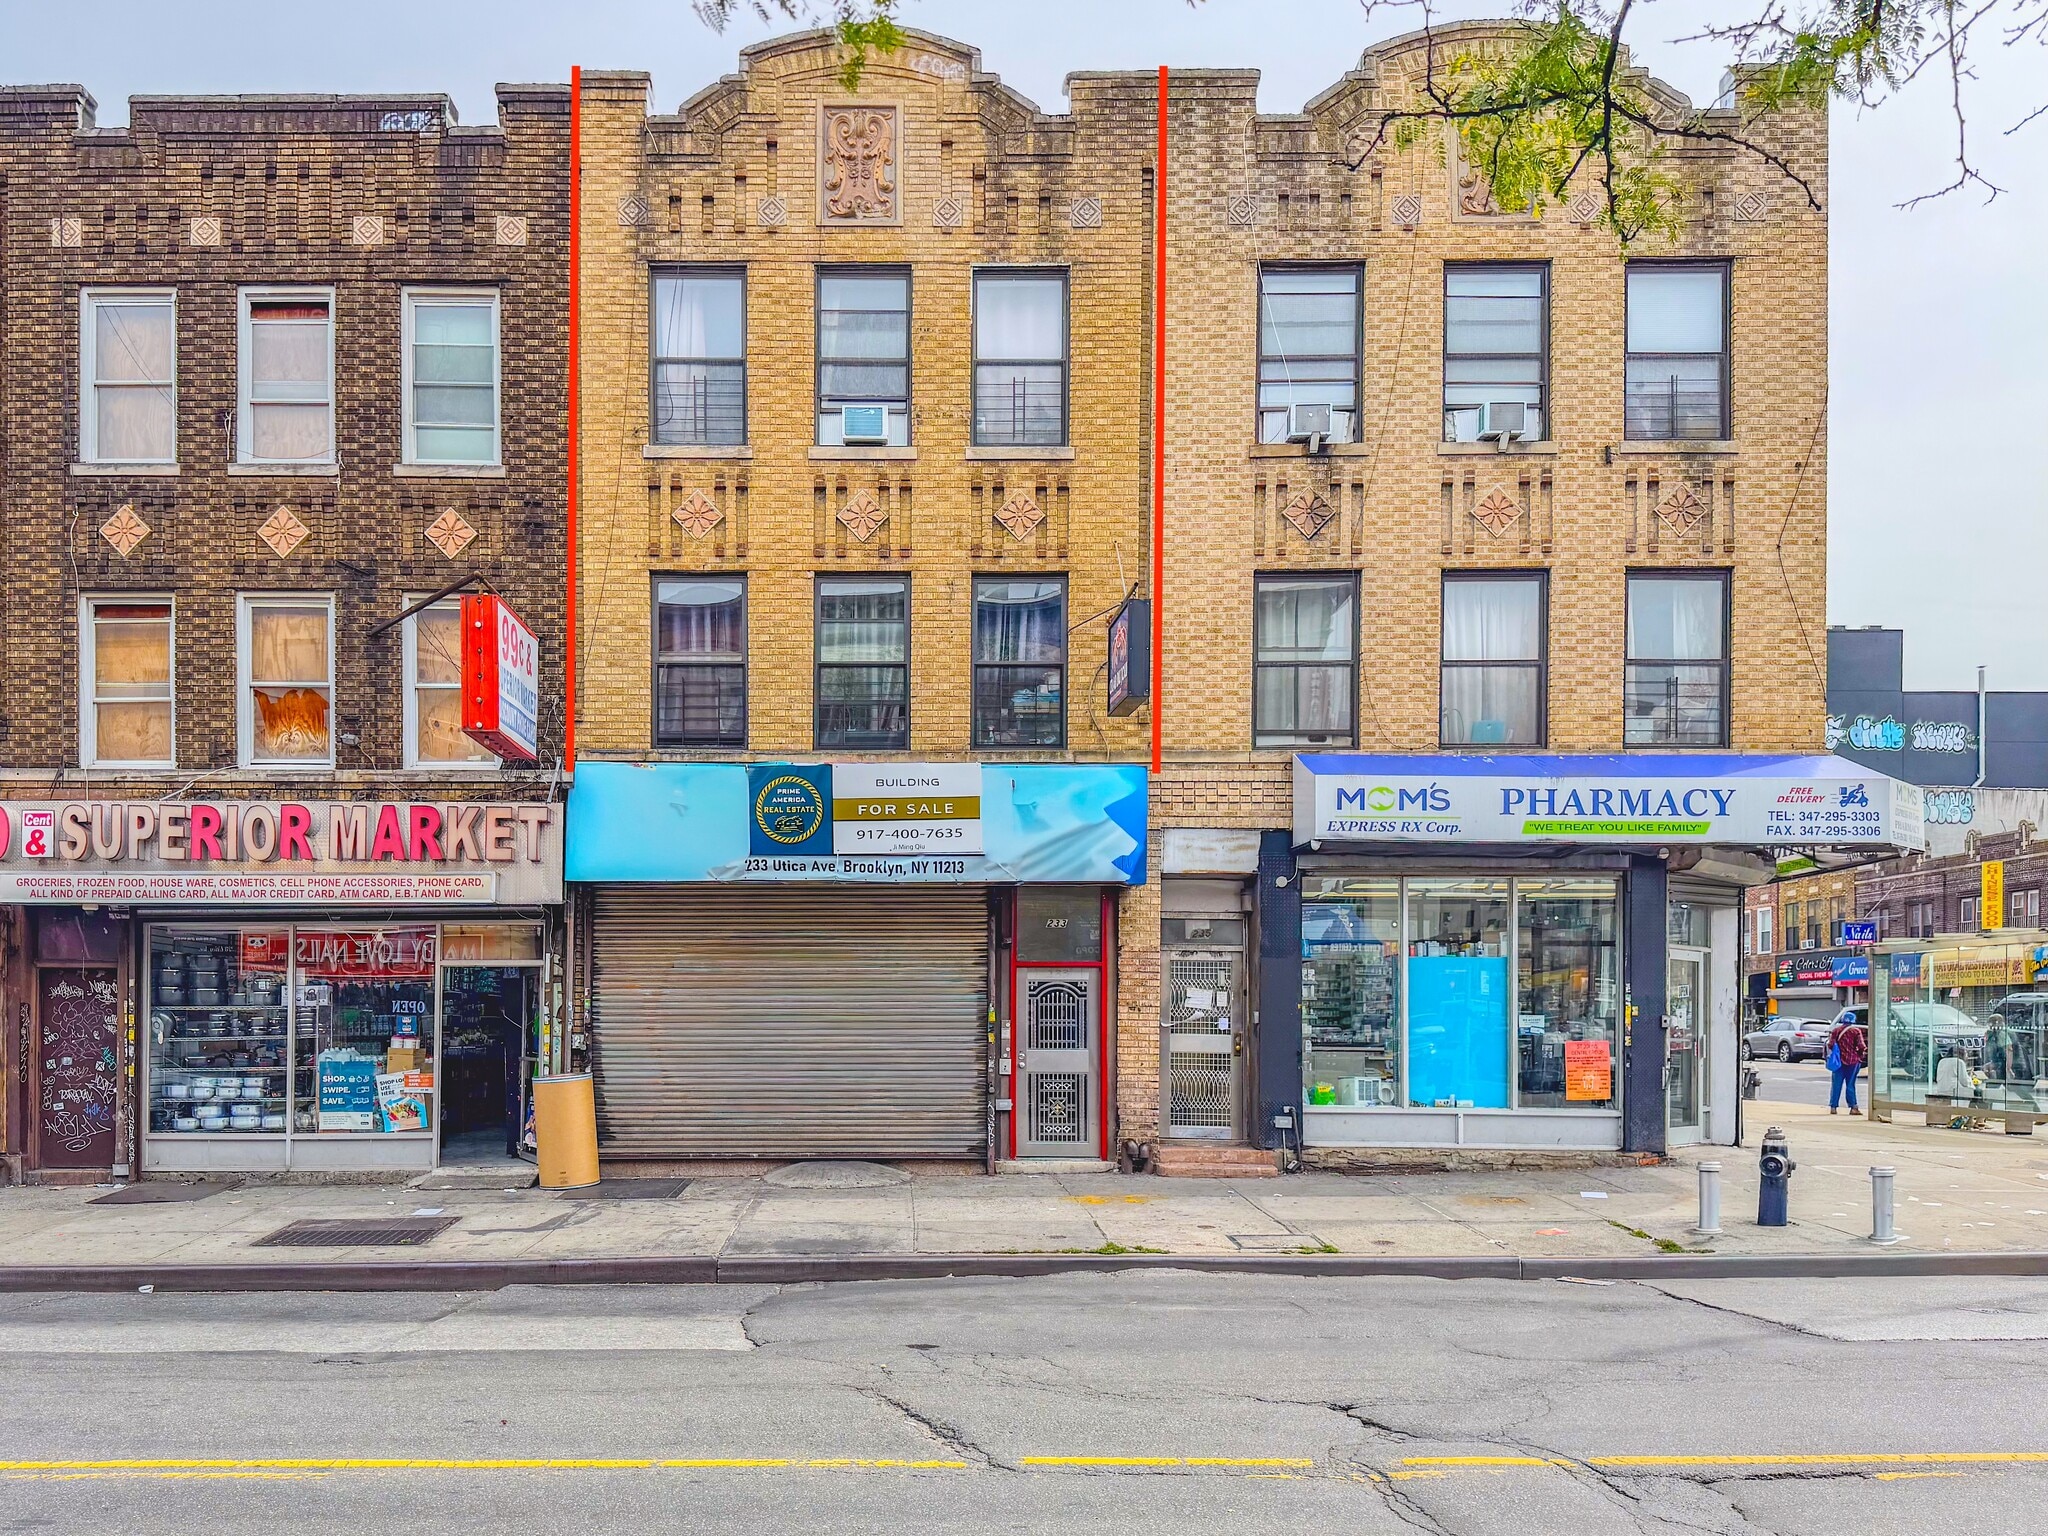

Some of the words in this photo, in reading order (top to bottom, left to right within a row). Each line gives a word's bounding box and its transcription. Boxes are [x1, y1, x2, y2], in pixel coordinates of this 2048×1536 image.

[876, 778, 940, 787] BUILDING
[1789, 787, 1813, 795] FREE
[1500, 788, 1736, 817] PHARMACY
[1777, 795, 1825, 803] DELIVERY
[858, 804, 896, 815] FOR
[906, 803, 954, 814] SALE
[25, 814, 51, 826] Cent
[1768, 811, 1795, 822] TEL:
[1799, 811, 1880, 822] 347-295-3303
[60, 804, 314, 861] SUPERIOR
[329, 804, 551, 862] MARKET
[1327, 821, 1396, 832] EXPRESS
[1400, 821, 1422, 832] RX
[1425, 821, 1462, 835] Corp.
[1529, 823, 1553, 831] "WE
[1557, 823, 1595, 831] TREAT
[1657, 824, 1702, 832] FAMILY"
[1767, 826, 1795, 836] FAX.
[1800, 826, 1881, 836] 347-295-3306
[856, 828, 963, 840] 917-400-7635
[25, 829, 46, 856] &
[745, 860, 768, 871] 233
[773, 860, 806, 871] Utica
[844, 861, 907, 875] Brooklyn,
[911, 861, 929, 873] NY
[932, 861, 964, 874] 11213
[16, 878, 75, 888] GROCERIES,
[78, 878, 114, 887] FROZEN
[118, 878, 148, 888] FOOD,
[150, 878, 181, 887] HOUSE
[186, 878, 216, 888] WARE,
[219, 878, 277, 888] COSMETICS,
[280, 878, 304, 887] CELL
[307, 878, 341, 887] PHONE
[344, 878, 416, 888] ACCESSORIES,
[418, 878, 451, 887] PHONE
[454, 878, 485, 888] CARD,
[30, 890, 48, 898] ALL
[50, 890, 73, 898] KIND
[76, 890, 89, 898] OF
[91, 890, 132, 898] PREPAID
[135, 890, 176, 898] CALLING
[179, 890, 208, 900] CARD,
[211, 890, 229, 898] ALL
[231, 890, 267, 898] MAJOR
[269, 890, 305, 898] CREDIT
[307, 890, 337, 900] CARD,
[340, 890, 360, 898] ATM
[363, 890, 392, 900] CARD,
[395, 890, 419, 898] E.B.T
[421, 890, 441, 898] AND
[443, 890, 465, 898] WIC.
[1046, 919, 1067, 927] 233
[1191, 929, 1211, 938] 235
[1845, 927, 1873, 940] Nails
[1849, 962, 1868, 975] Grace
[1895, 960, 1910, 977] Spa
[322, 1075, 346, 1083] SHOP.
